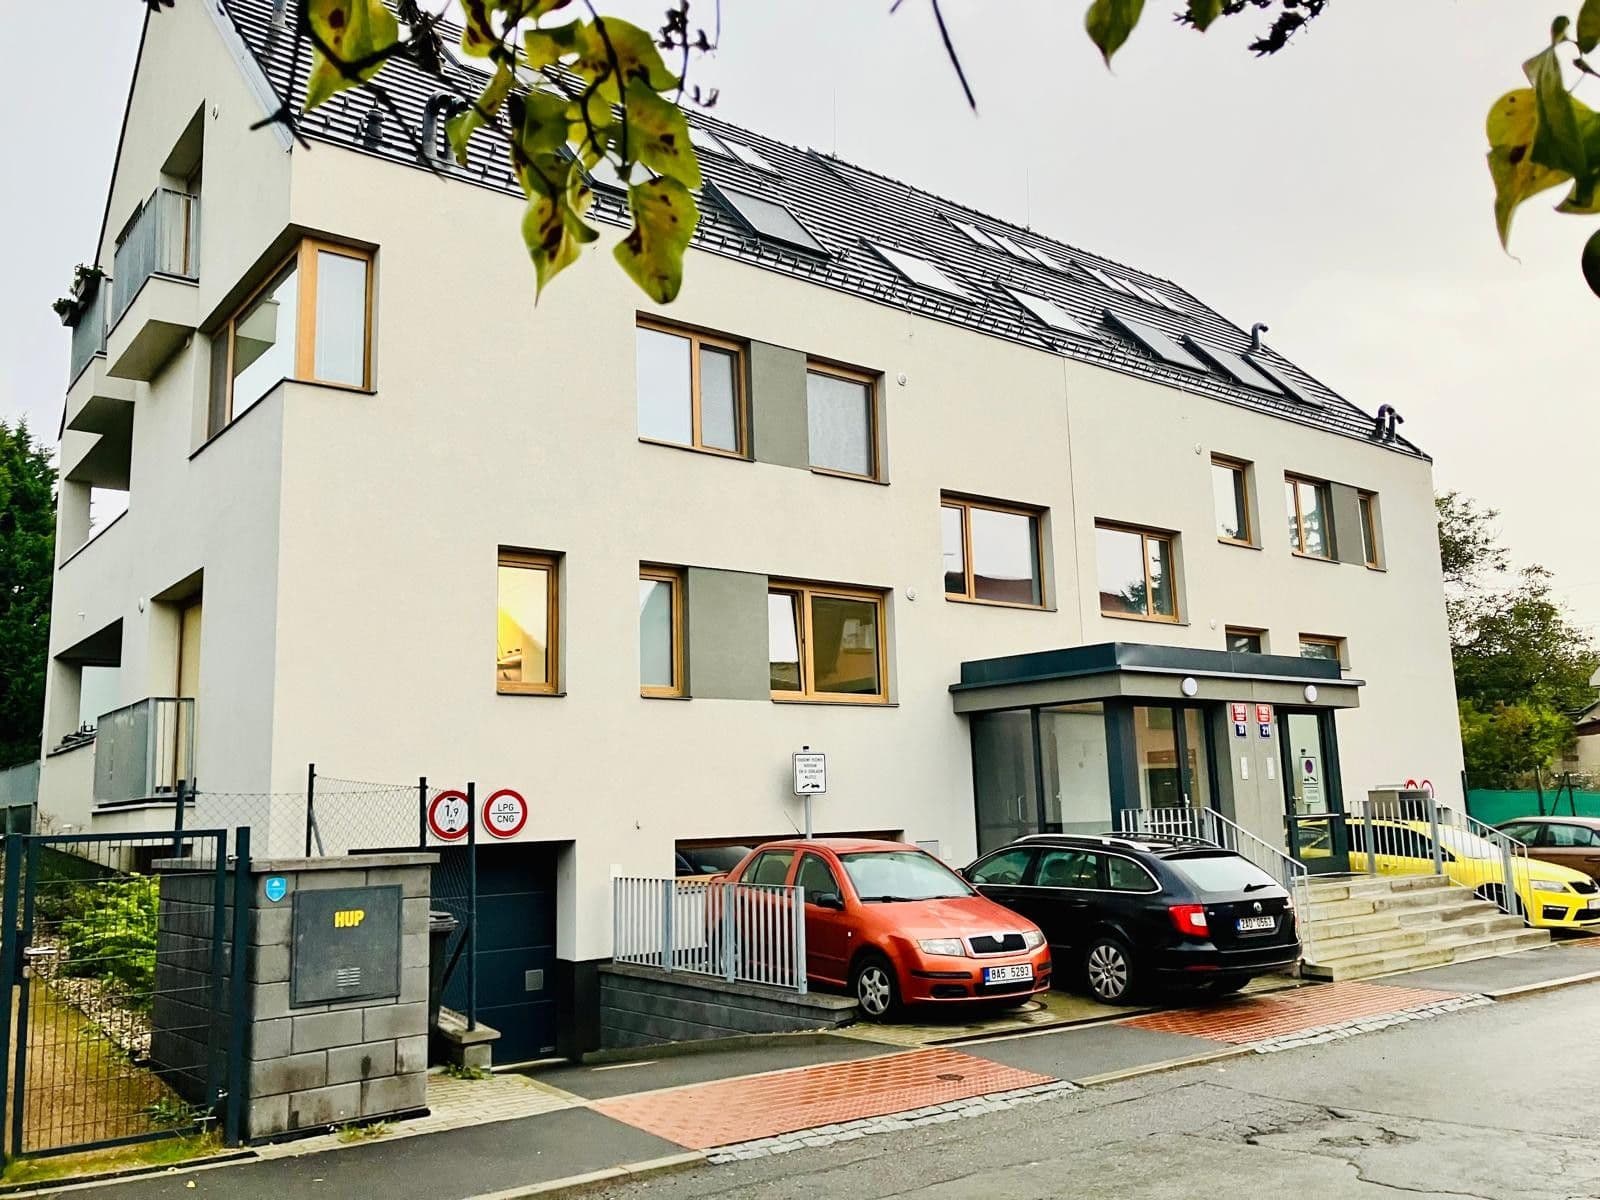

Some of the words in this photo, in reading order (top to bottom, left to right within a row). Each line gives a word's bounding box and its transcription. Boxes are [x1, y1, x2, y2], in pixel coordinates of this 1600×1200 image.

[445, 805, 459, 817] 1,9
[497, 803, 514, 812] LPG
[497, 815, 515, 823] CNG
[334, 910, 365, 928] HUP
[991, 968, 1006, 980] 8A5
[1010, 966, 1029, 978] 5293
